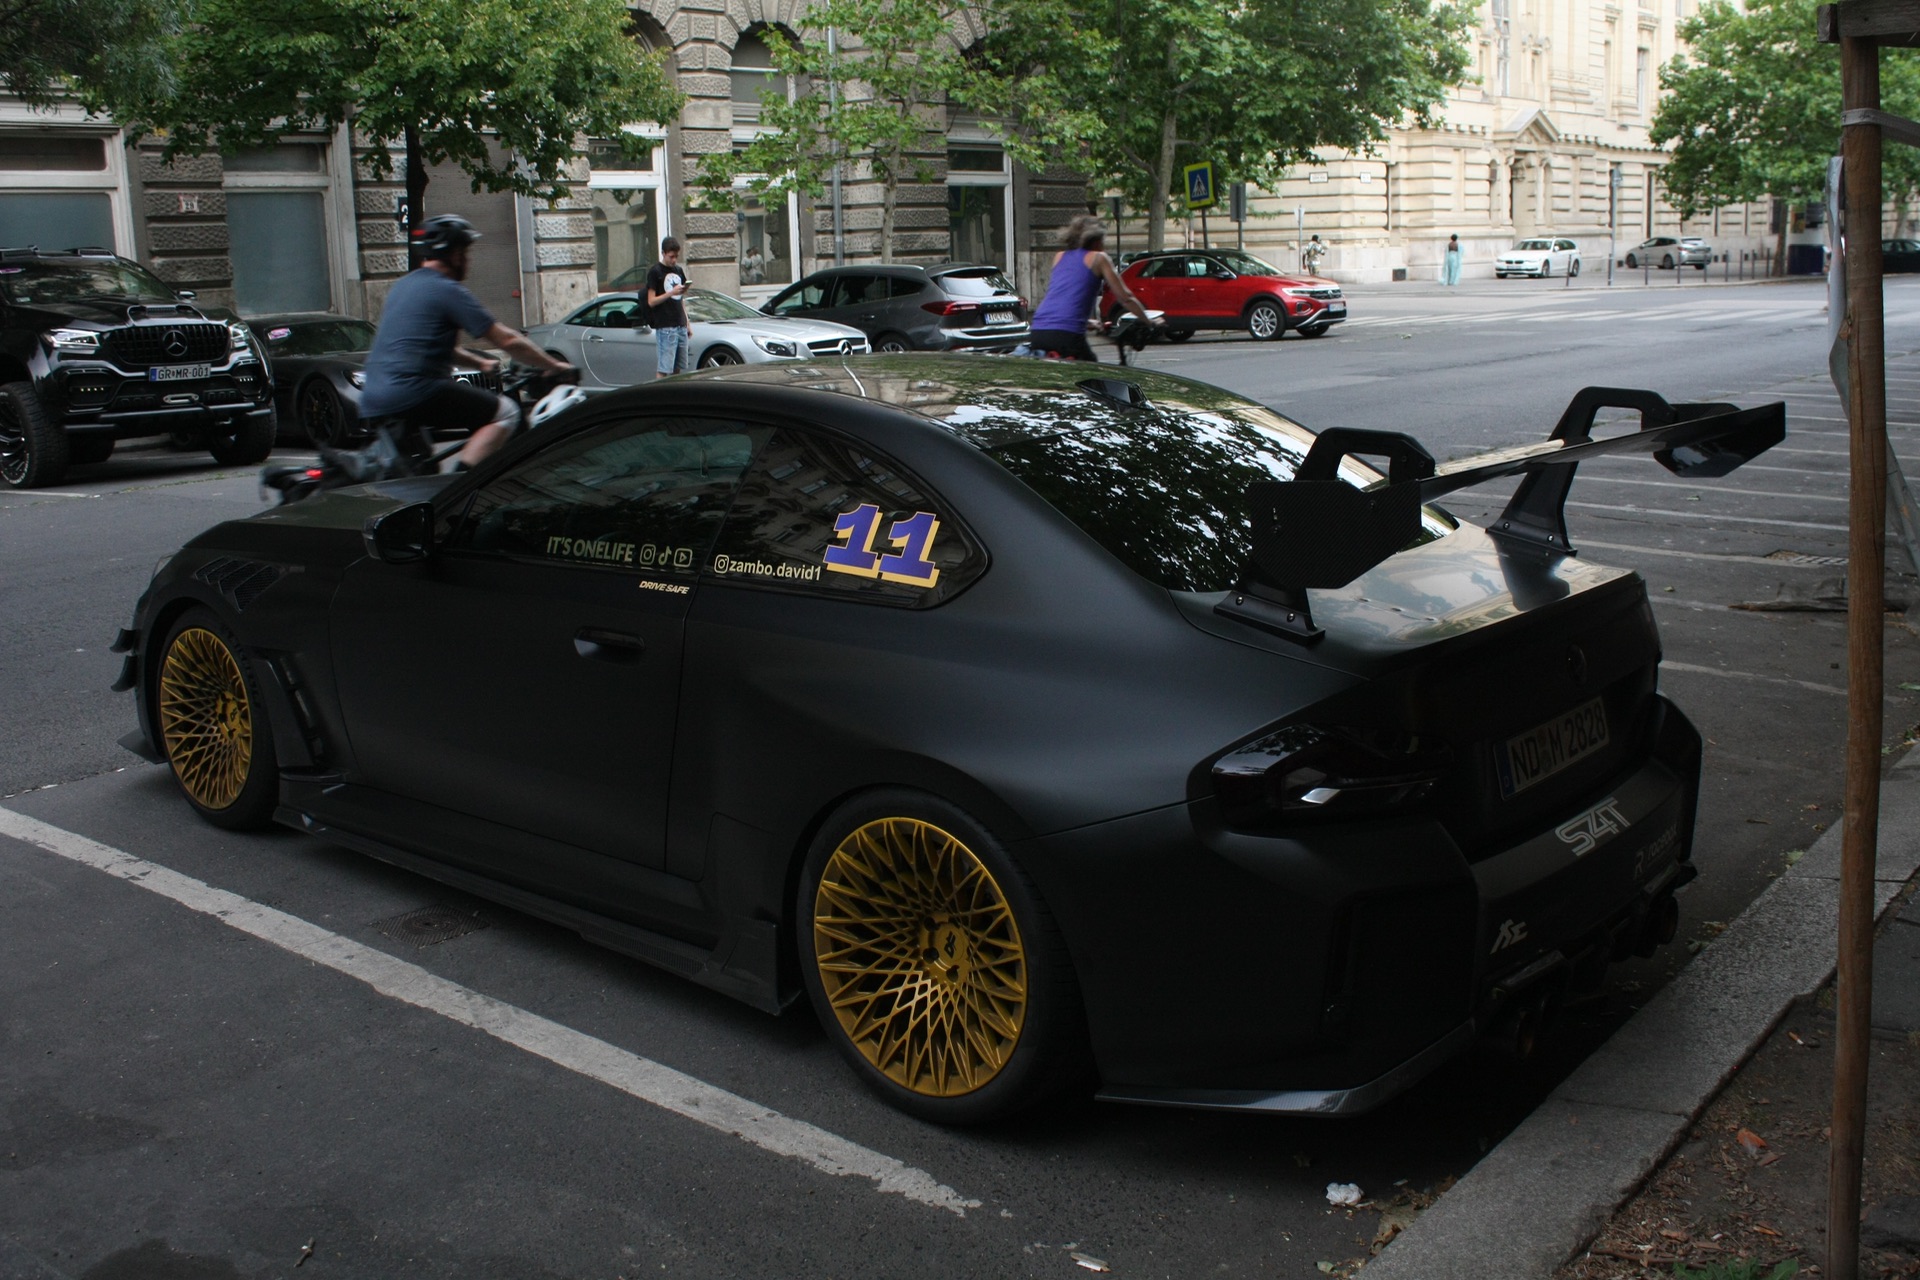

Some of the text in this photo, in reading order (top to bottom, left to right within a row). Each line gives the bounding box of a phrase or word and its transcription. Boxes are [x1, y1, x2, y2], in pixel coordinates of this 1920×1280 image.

[175, 366, 209, 379] MR-001
[546, 536, 635, 563] IT'S ONELIFE
[822, 503, 941, 589] 11
[728, 559, 823, 581] zambo.david1
[639, 580, 690, 595] DRIVE SAFE
[1510, 701, 1606, 785] ND M 2828
